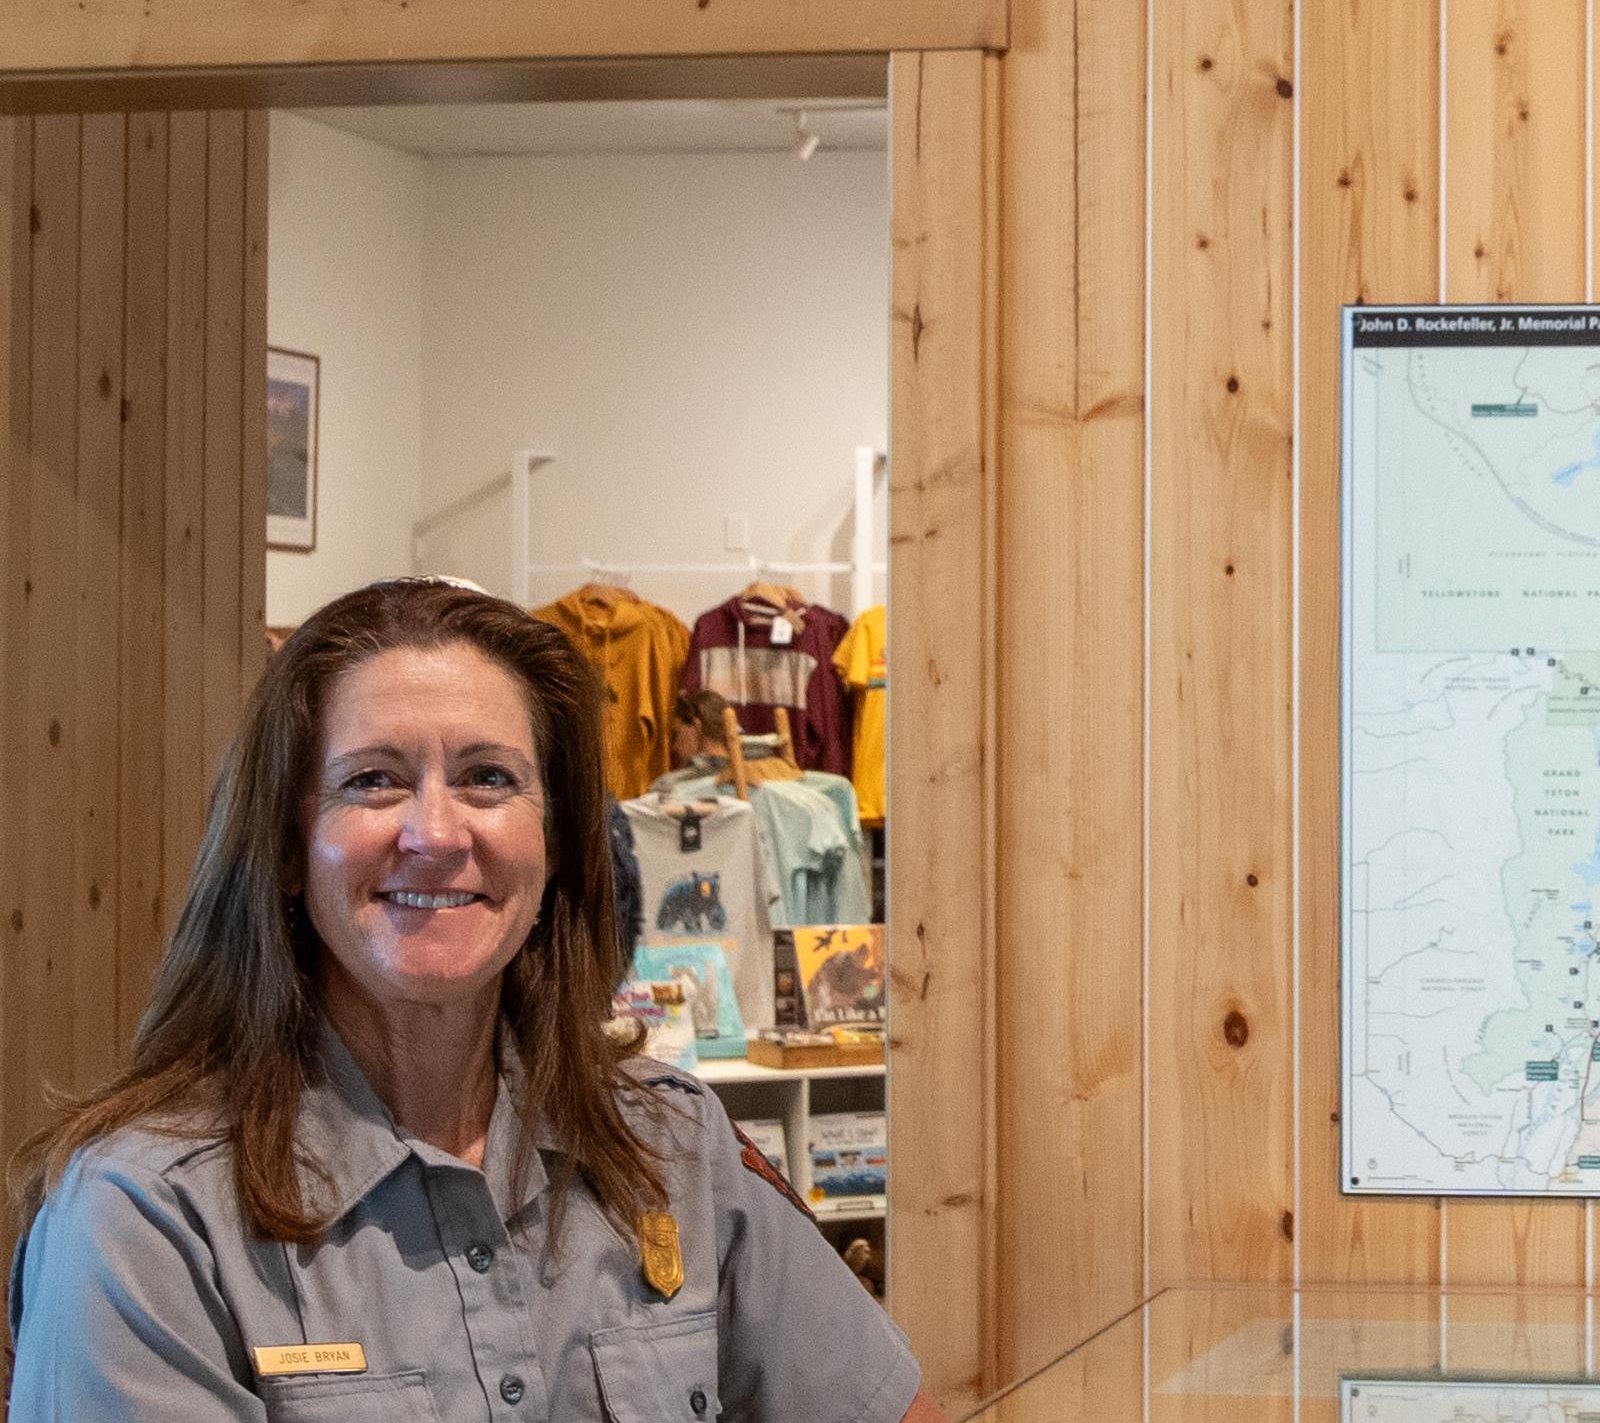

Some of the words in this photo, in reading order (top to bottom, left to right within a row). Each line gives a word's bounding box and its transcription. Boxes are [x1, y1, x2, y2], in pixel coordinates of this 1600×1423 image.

[1359, 318, 1394, 332] John
[1397, 318, 1412, 331] D.
[1416, 317, 1496, 332] Rockefeller,
[1518, 316, 1585, 331] Memorial
[279, 1352, 310, 1365] JOSIE
[315, 1350, 351, 1363] BRYAN
